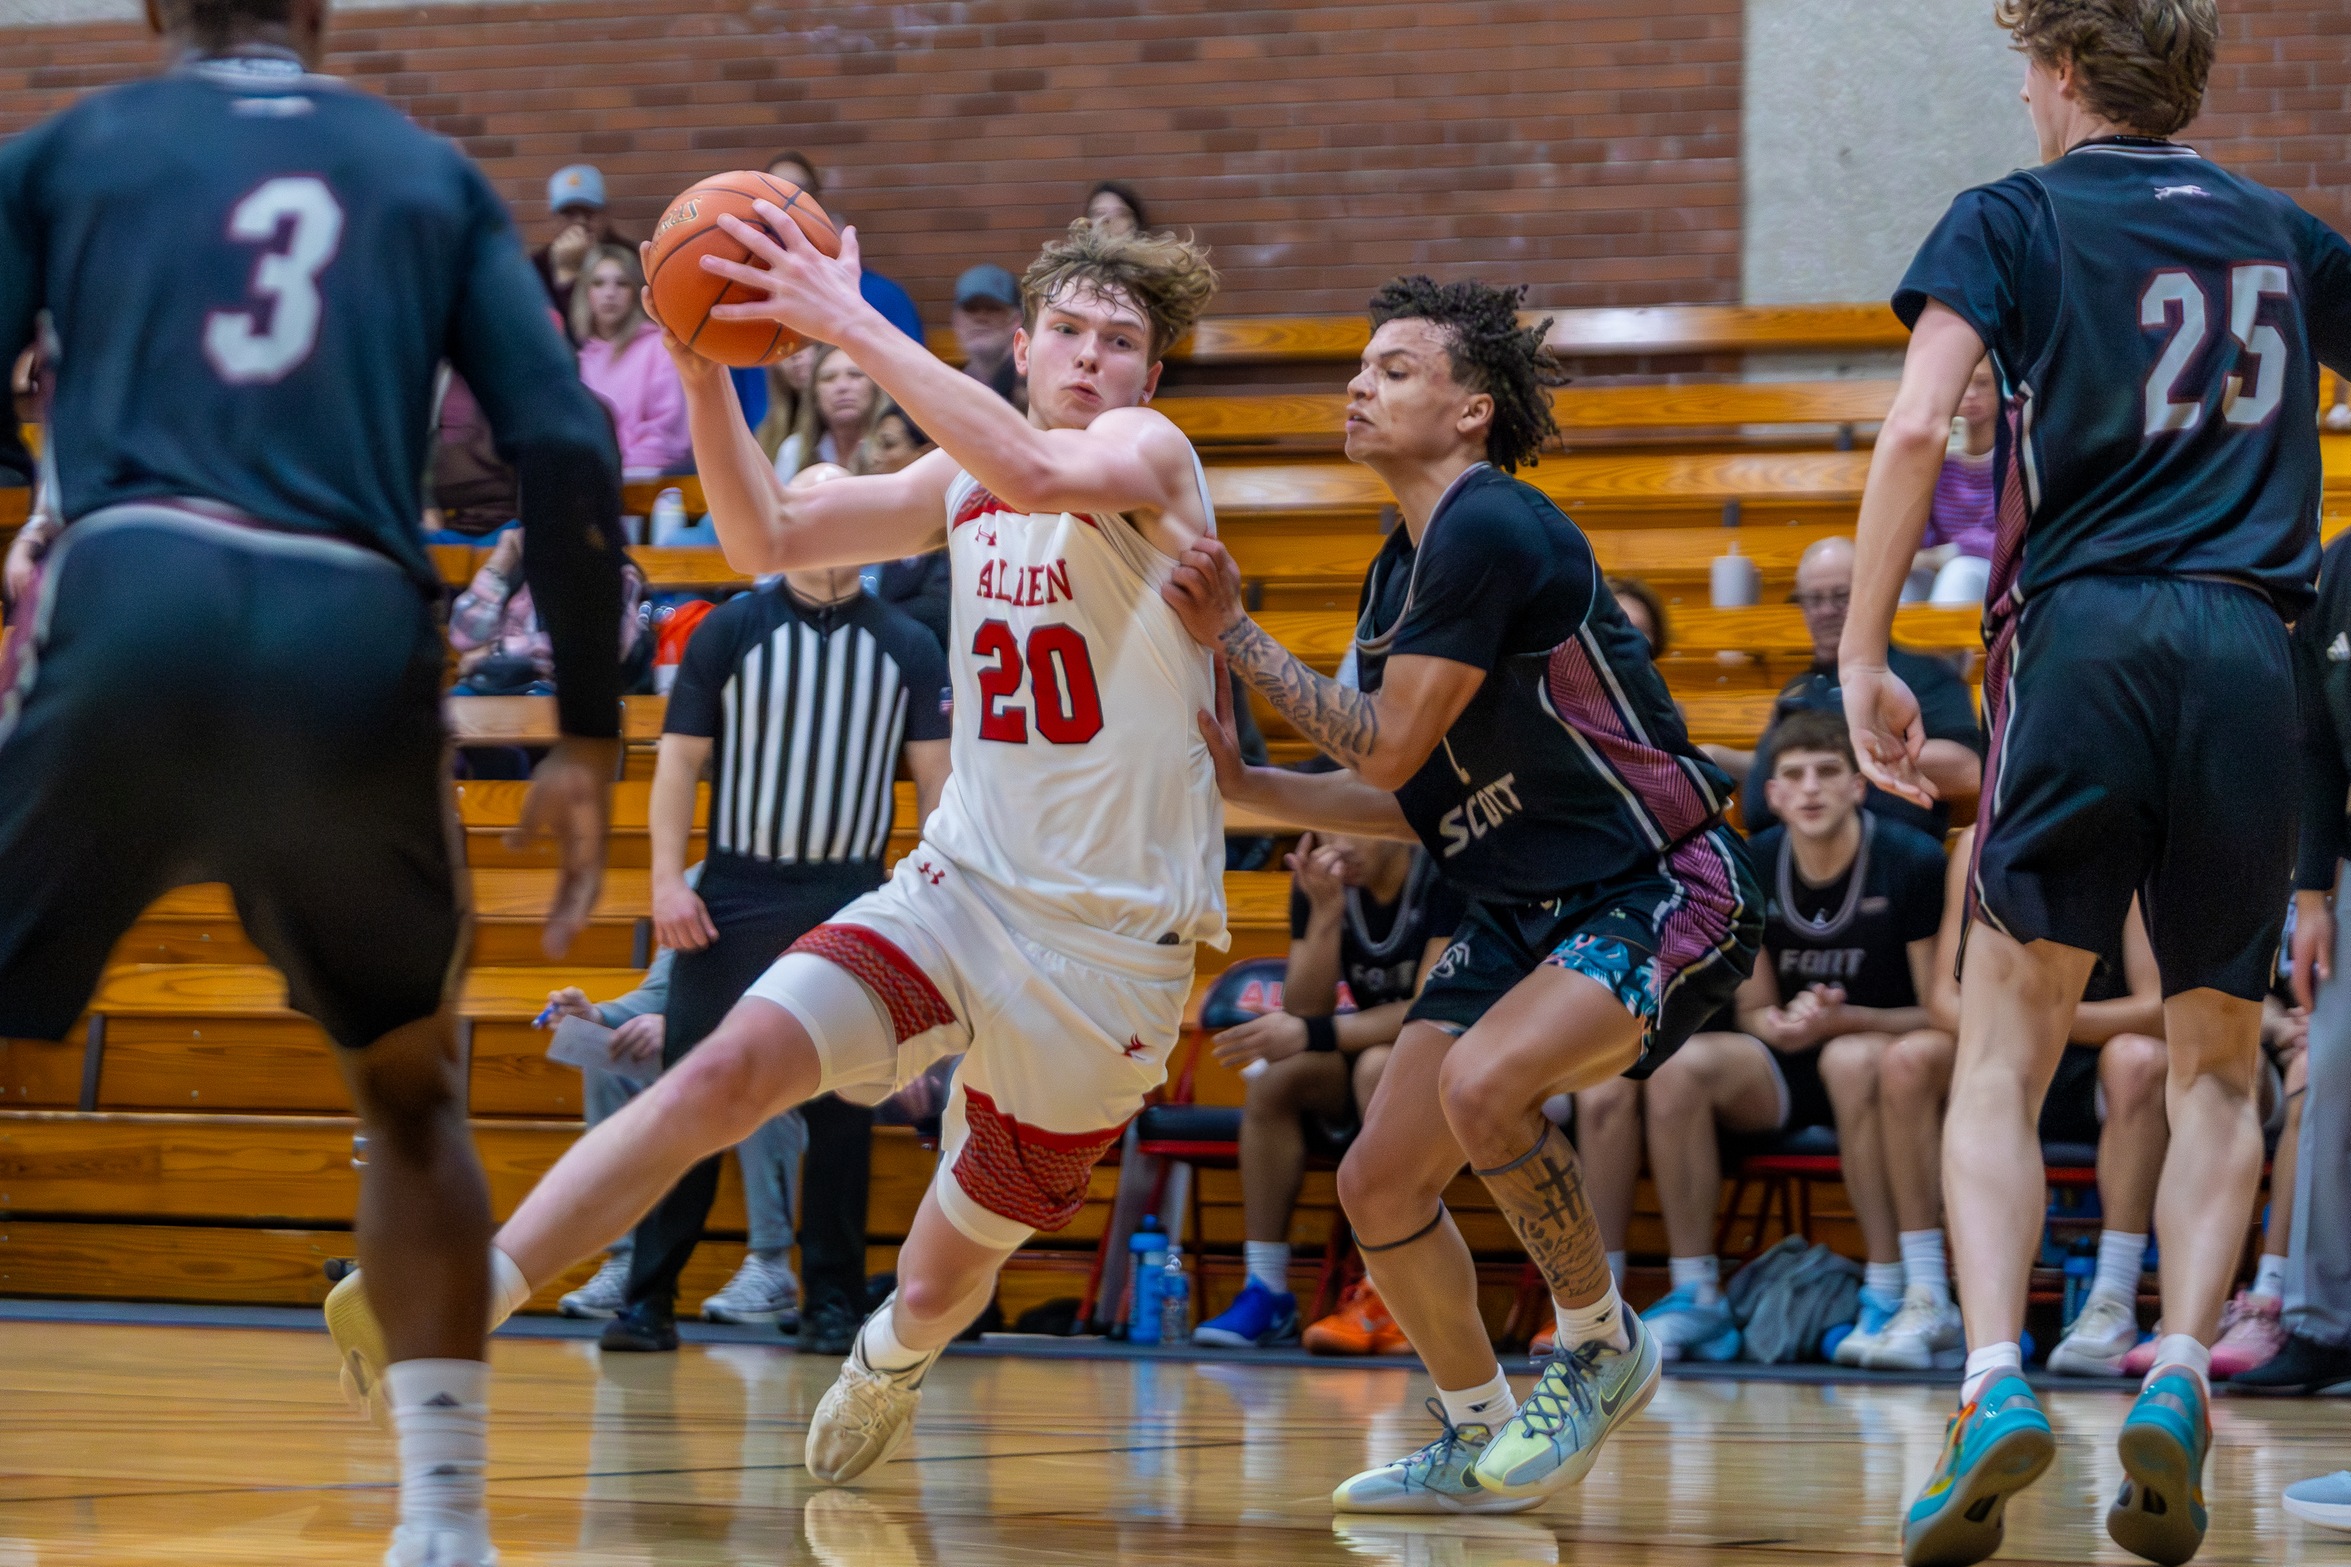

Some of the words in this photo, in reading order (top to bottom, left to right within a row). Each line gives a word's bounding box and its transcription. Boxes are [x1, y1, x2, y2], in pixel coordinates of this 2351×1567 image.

[203, 169, 346, 385] 3
[2136, 260, 2292, 437] 25
[971, 617, 1104, 744] 20
[1438, 771, 1523, 859] SCOTT
